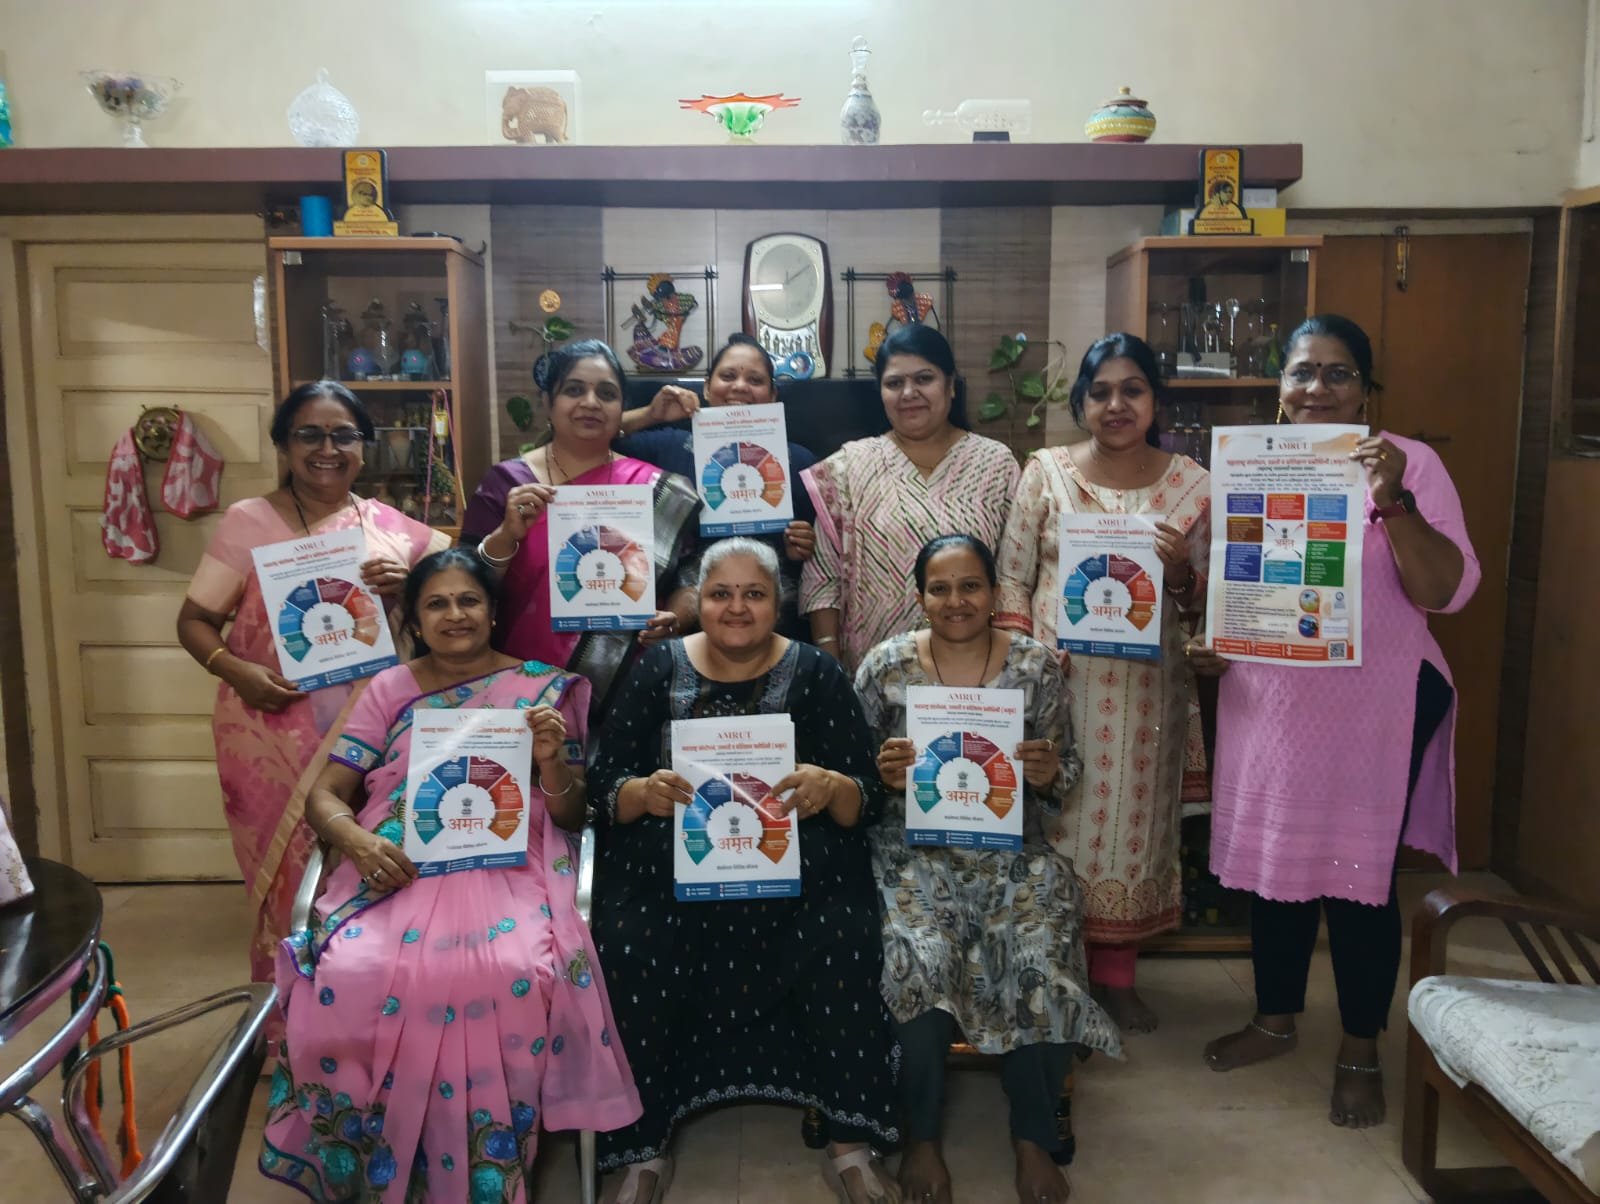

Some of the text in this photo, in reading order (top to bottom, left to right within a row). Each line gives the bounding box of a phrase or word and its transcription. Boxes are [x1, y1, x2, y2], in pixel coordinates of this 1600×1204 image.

[948, 693, 982, 701] AMRUT
[717, 731, 752, 739] AMRUT
[945, 790, 980, 807] अमृत
[448, 817, 486, 834] अमृत
[718, 836, 753, 854] अमृत
